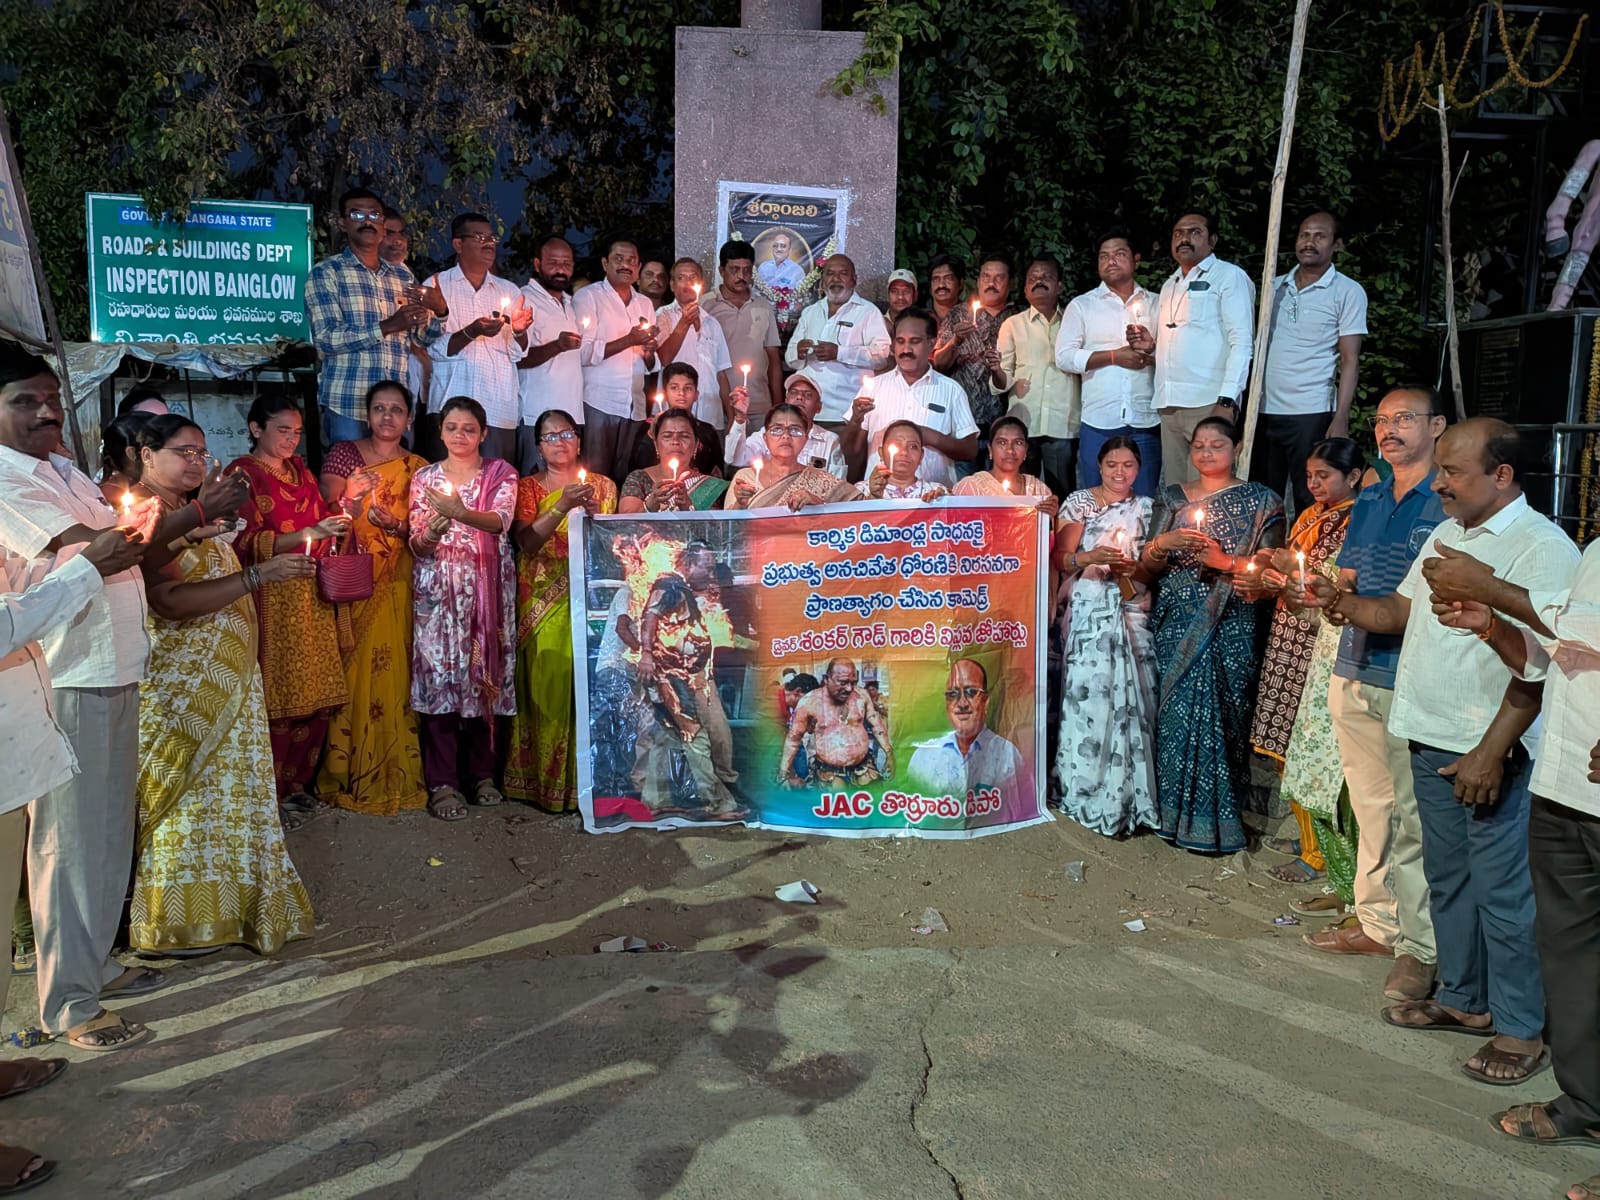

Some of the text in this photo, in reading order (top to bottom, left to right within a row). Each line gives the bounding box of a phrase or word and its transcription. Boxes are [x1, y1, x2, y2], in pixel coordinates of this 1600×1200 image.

[170, 212, 237, 225] LANGANA
[240, 216, 272, 227] STATE
[102, 235, 293, 263] ROADS & BUILDINGS DEPT
[106, 267, 296, 300] INSPECTION BANGLOW
[108, 302, 303, 327] రహదారులు మరియు భవనముల శాఖ
[808, 521, 984, 551] కార్మిక డిమాండ్ల సాధనకై
[762, 552, 1020, 586] ప్రభుత్వ అనచివేత ధోరణికి నిరసనగా
[805, 593, 894, 618] ప్రాణత్యాగం
[897, 587, 943, 610] చేసిన
[799, 626, 848, 653] శంకర్
[851, 623, 887, 648] గౌడ్
[890, 623, 936, 647] గారికి
[939, 625, 974, 651] విప్లవ
[975, 619, 1027, 648] జోహార్లు
[813, 788, 1001, 822] JAC తొర్రూరు డిపో
